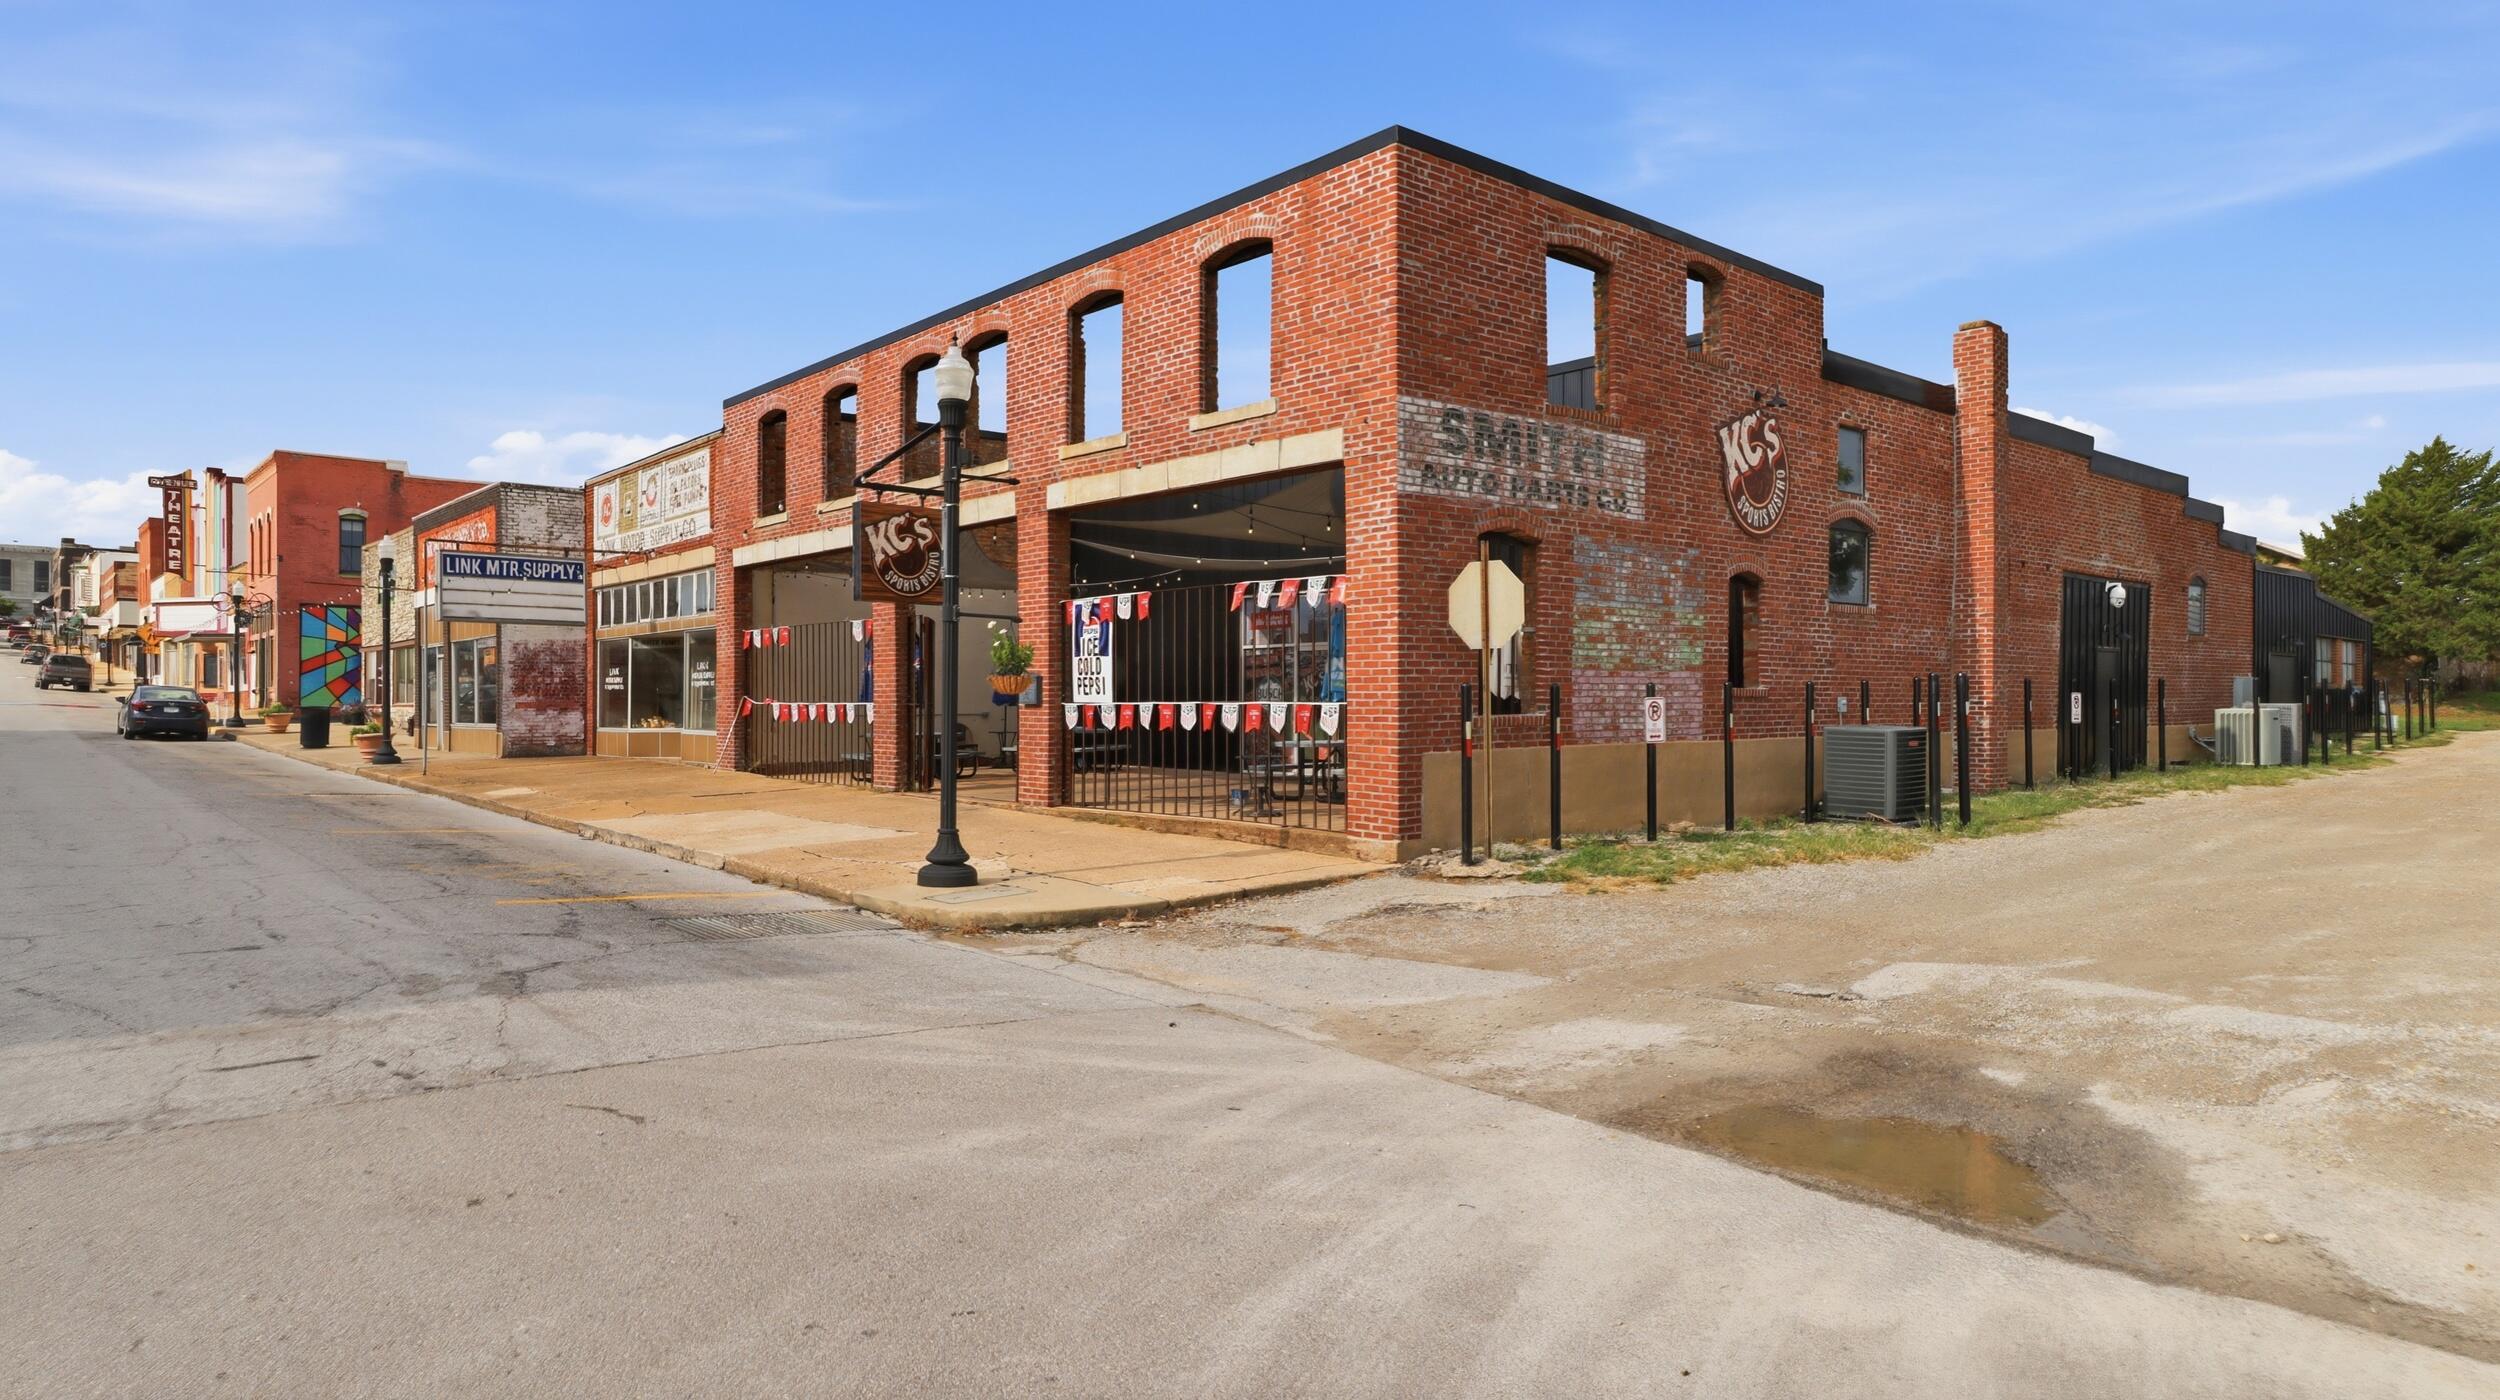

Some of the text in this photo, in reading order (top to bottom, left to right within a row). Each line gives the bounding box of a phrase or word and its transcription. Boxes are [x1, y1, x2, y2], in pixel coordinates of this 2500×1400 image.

[1440, 407, 1604, 478] SMITH
[1422, 464, 1498, 497] AUTO
[1511, 475, 1590, 507] PARTS
[1737, 469, 1786, 527] SPORTS BISTRO
[167, 490, 181, 569] THEATRE
[446, 557, 481, 575] LINK
[884, 551, 940, 593] SPORTS BISTRO
[1077, 656, 1102, 676] COLD
[1082, 637, 1099, 656] ICE
[1077, 676, 1106, 696] PEPSI
